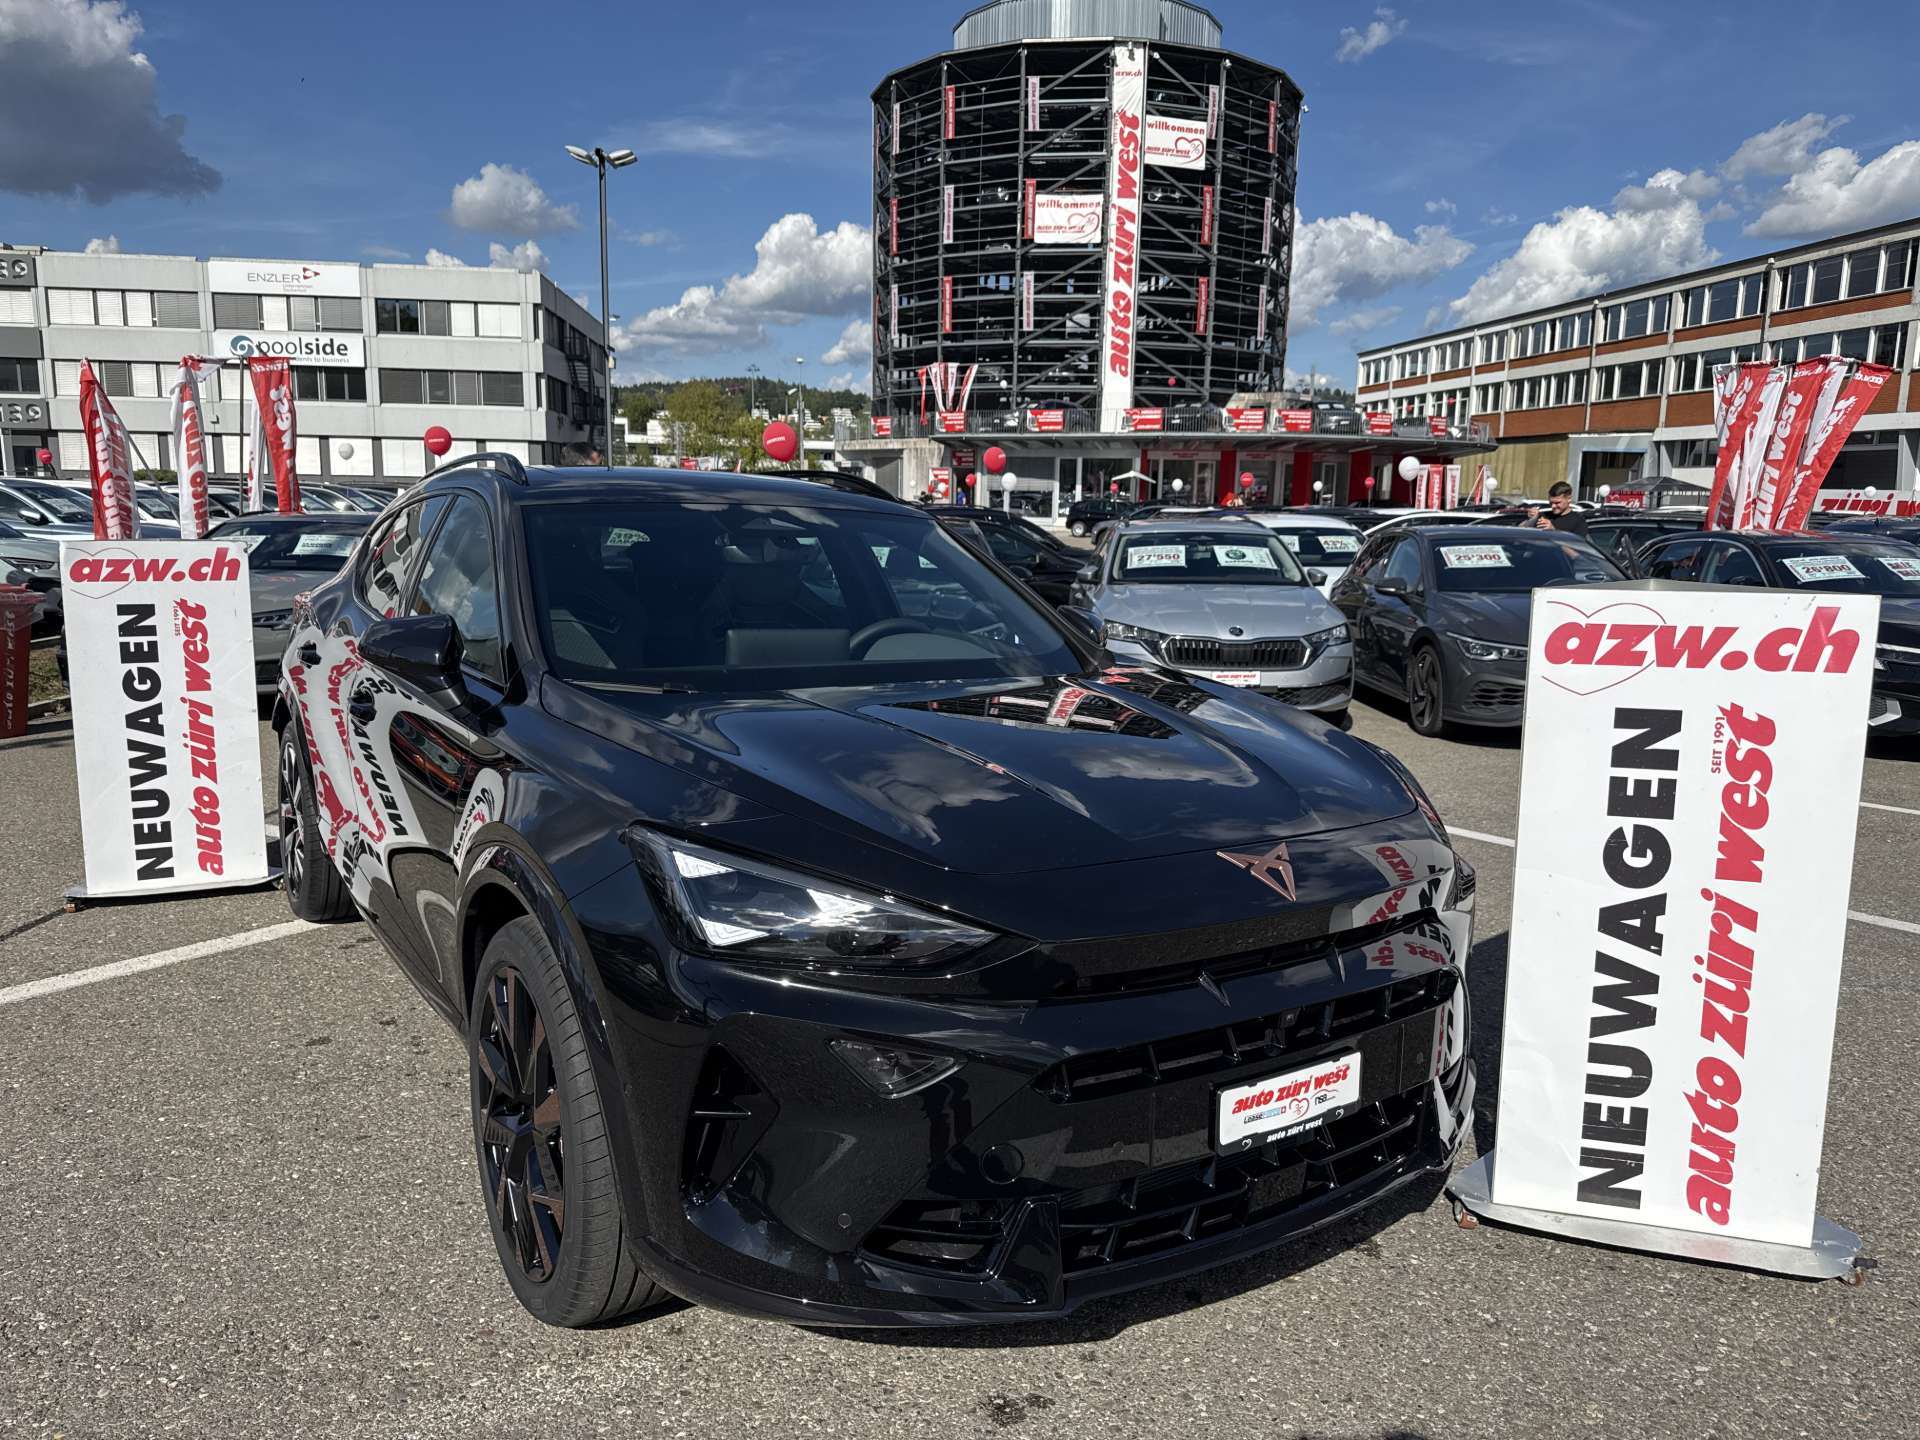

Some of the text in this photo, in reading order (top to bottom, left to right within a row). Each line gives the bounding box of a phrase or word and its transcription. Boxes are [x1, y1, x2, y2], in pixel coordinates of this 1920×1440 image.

[1147, 120, 1205, 135] willkommen
[1037, 199, 1101, 210] willkommen
[1108, 108, 1140, 378] auto züri west
[247, 272, 301, 284] ENZLER
[256, 337, 348, 358] poolside
[69, 547, 241, 583] azw.ch
[1137, 553, 1181, 562] 27'550
[1802, 564, 1851, 574] 26'800
[1544, 606, 1860, 674] azw.ch
[116, 603, 175, 881] NEUWAGEN
[174, 598, 224, 876] auto züri west
[1710, 715, 1725, 774] SEIT 1991
[1576, 706, 1684, 1211] NEUWAGEN
[1683, 702, 1777, 1226] auto züri west
[1232, 1063, 1350, 1114] auto züri west
[1266, 1118, 1323, 1143] auto züri west
